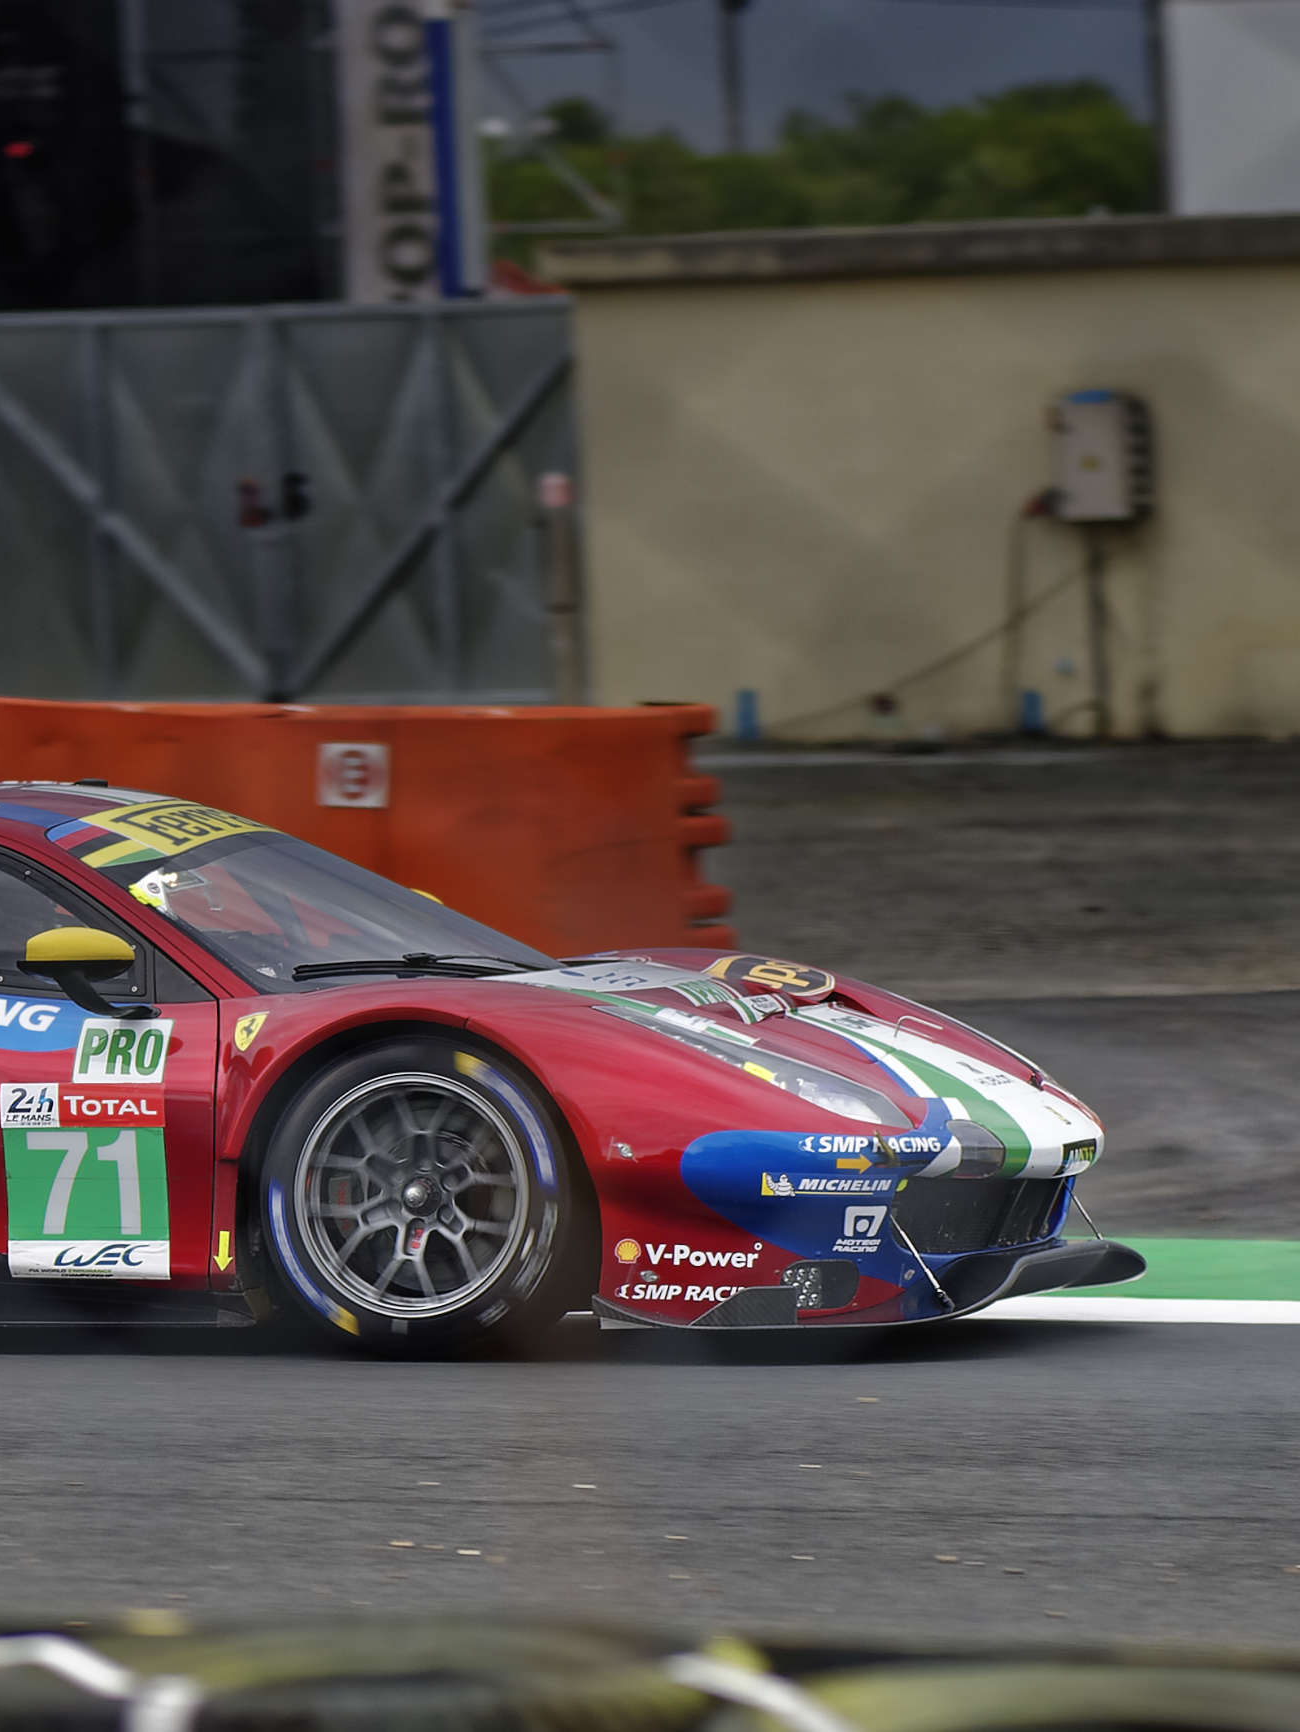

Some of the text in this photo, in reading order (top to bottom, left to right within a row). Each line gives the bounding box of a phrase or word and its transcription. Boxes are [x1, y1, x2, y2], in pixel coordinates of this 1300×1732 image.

[79, 1028, 164, 1076] PRO
[7, 1088, 53, 1113] 24h
[63, 1096, 157, 1116] TOTAL
[819, 1136, 869, 1153] SMP
[26, 1130, 141, 1235] 71
[798, 1178, 892, 1192] MICHELIN
[54, 1244, 150, 1267] WEC
[645, 1243, 760, 1268] V-Power
[632, 1284, 682, 1300] SMP
